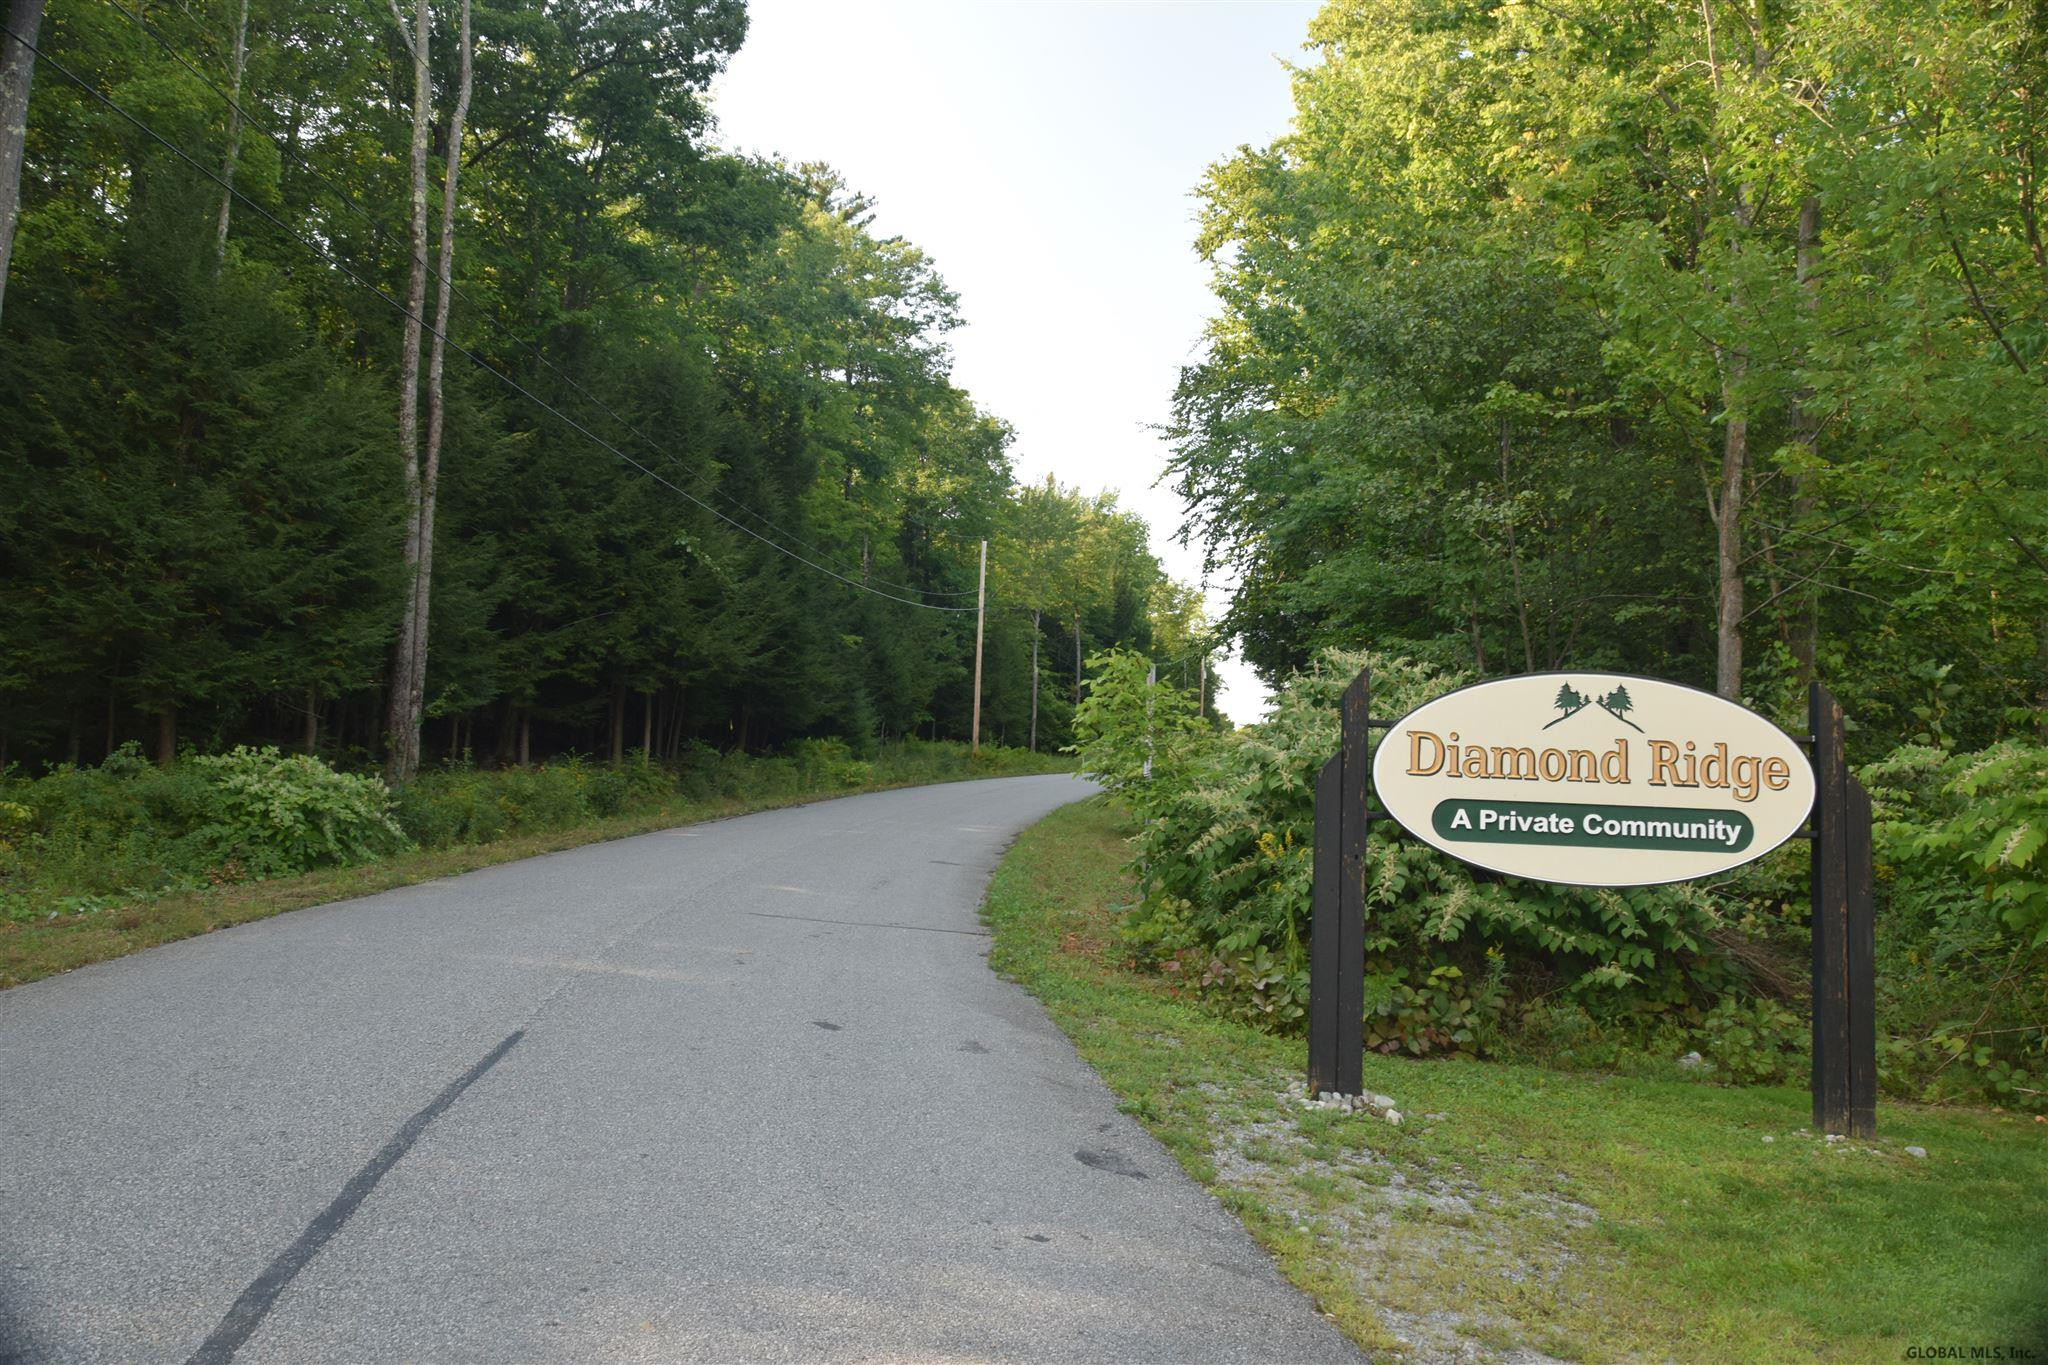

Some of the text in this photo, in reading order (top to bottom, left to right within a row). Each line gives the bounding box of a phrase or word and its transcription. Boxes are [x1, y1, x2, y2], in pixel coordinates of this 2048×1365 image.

[1405, 730, 1790, 802] Diamond Ridge
[1450, 808, 1742, 845] A Private Community
